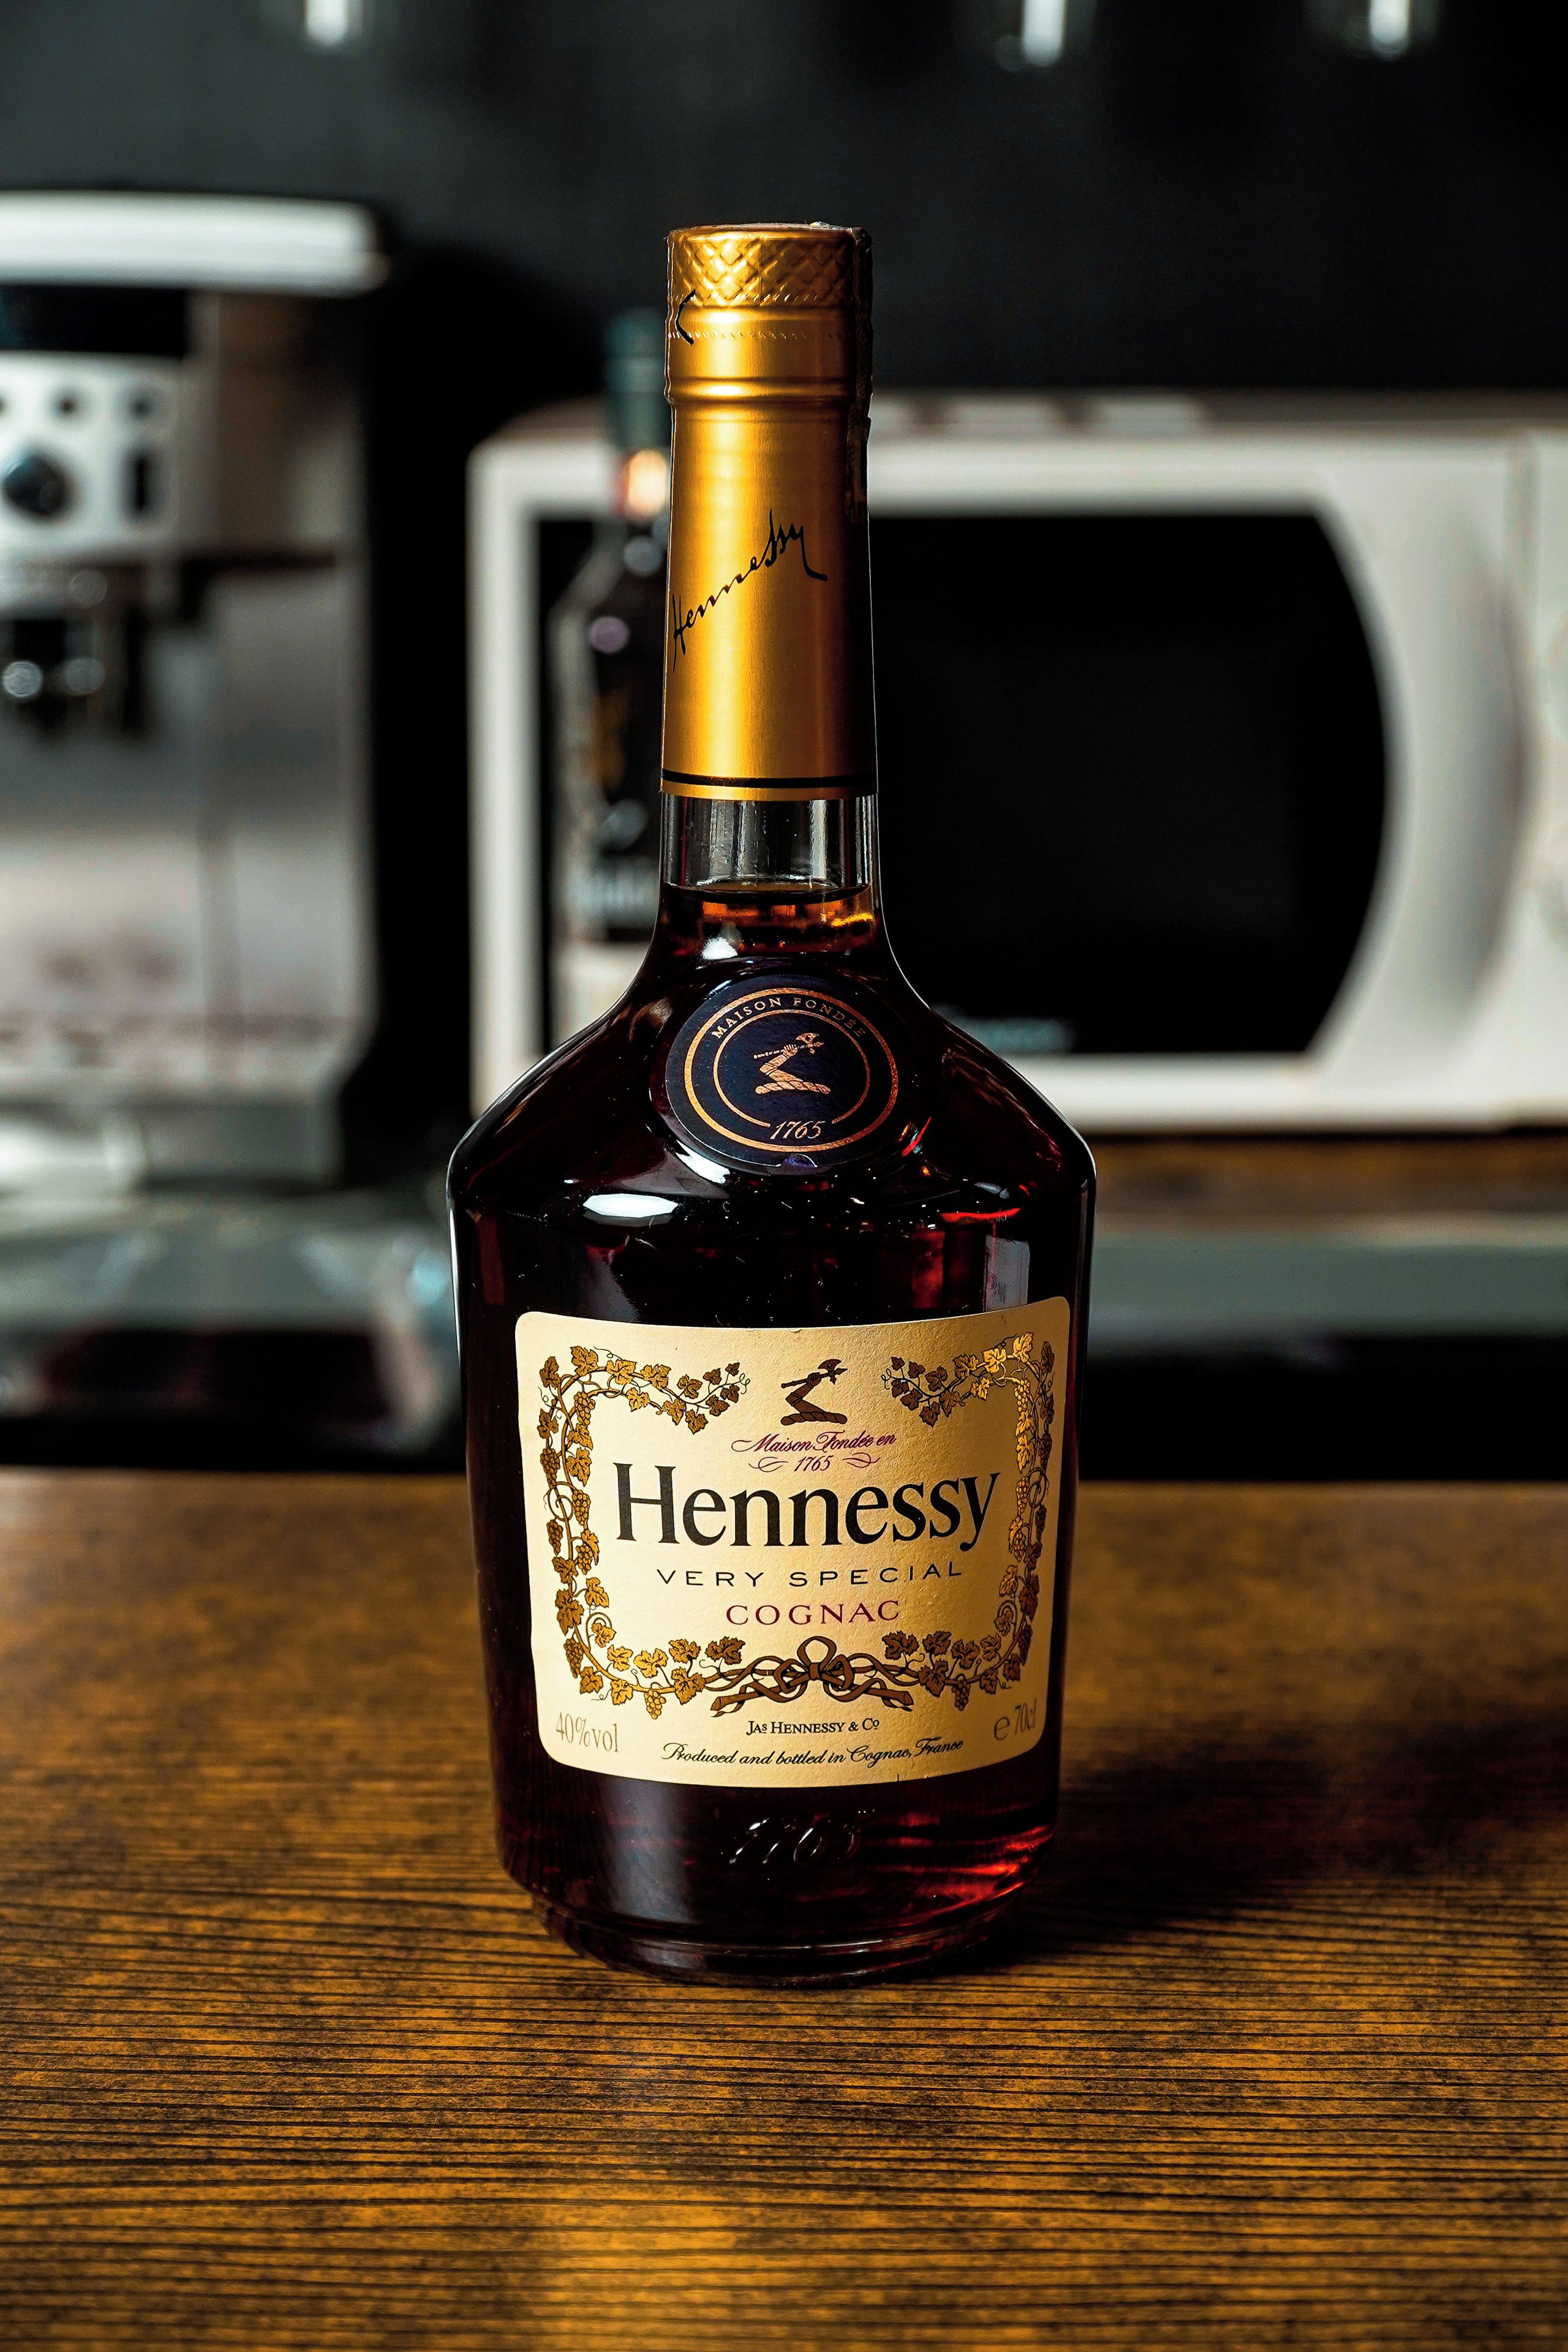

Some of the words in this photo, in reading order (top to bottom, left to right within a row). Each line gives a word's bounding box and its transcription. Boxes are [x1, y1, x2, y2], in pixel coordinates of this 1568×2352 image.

[673, 509, 829, 673] Hennessy
[711, 997, 782, 1039] MAISON
[769, 1120, 827, 1140] 1765
[731, 1433, 813, 1452] Maison
[813, 1430, 873, 1453] Fondée
[875, 1433, 897, 1446] en
[793, 1455, 835, 1472] 1765
[612, 1461, 1001, 1553] Hennessy
[656, 1569, 764, 1588] VERY
[788, 1561, 963, 1587] SPECIAL
[726, 1599, 900, 1626] COGNAC
[770, 1721, 846, 1734] HENNESSY
[848, 1721, 859, 1732] &
[661, 1742, 739, 1764] Produced
[739, 1750, 776, 1765] and
[775, 1749, 827, 1765] bottled
[827, 1751, 846, 1764] in
[846, 1745, 913, 1769] Cognac,
[914, 1736, 965, 1757] France
